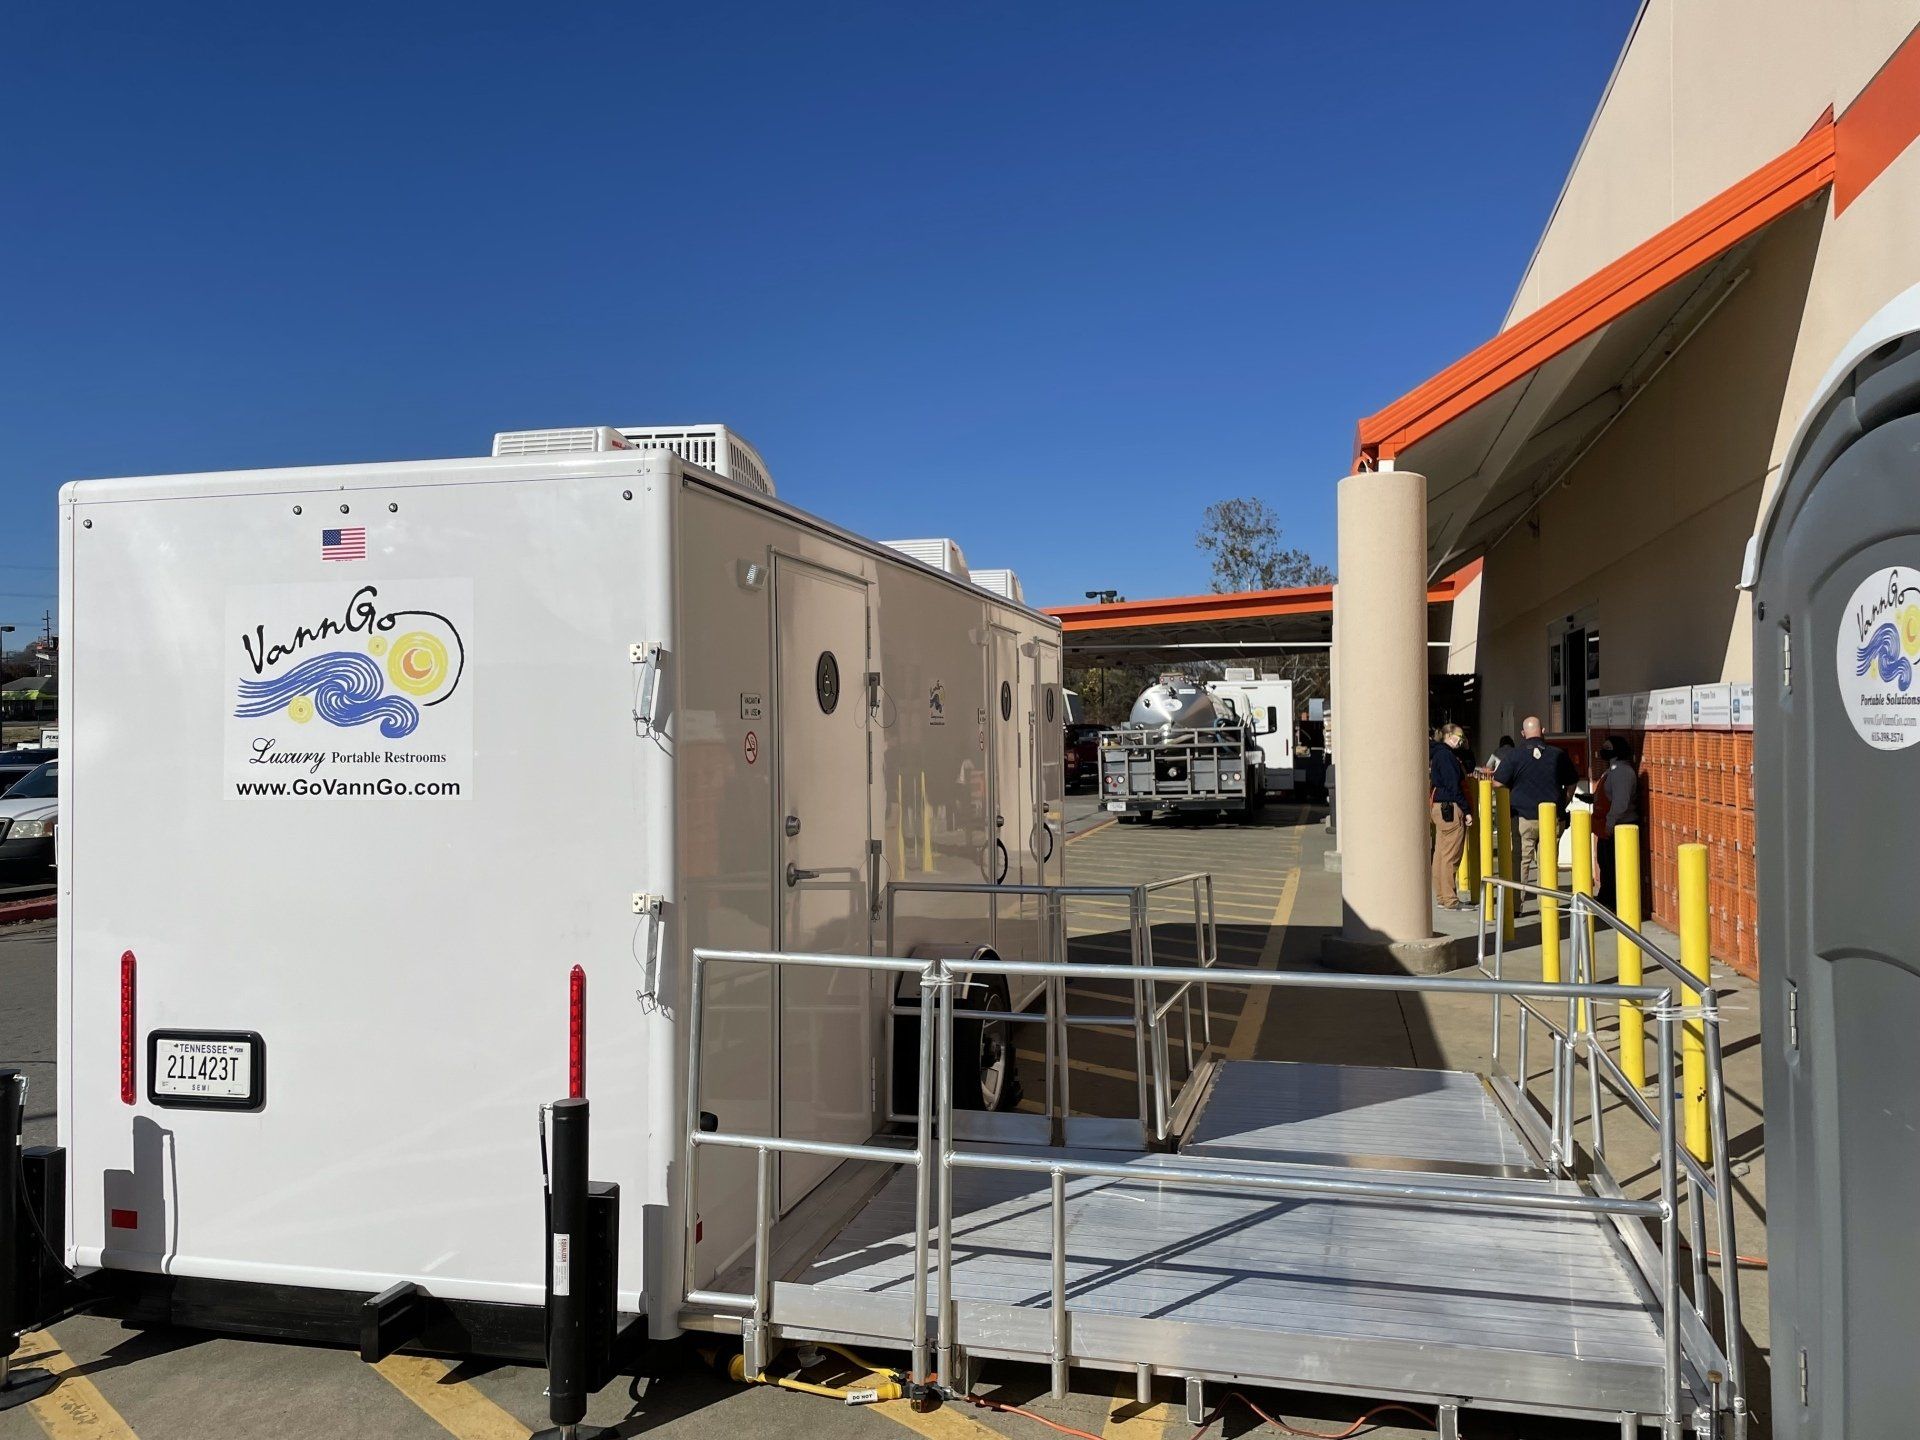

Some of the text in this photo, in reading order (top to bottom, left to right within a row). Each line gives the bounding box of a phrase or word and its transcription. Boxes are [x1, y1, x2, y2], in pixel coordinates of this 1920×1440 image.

[1857, 569, 1905, 643] VannGo
[242, 586, 395, 674] VannGo
[1861, 694, 1885, 706] Portable
[249, 737, 447, 773] Luxury Portable Restrooms
[236, 778, 461, 796] www.GoVannGo.com
[179, 1043, 228, 1054] TENNESSEE
[167, 1055, 239, 1082] 211423T
[191, 1084, 210, 1092] SEMI
